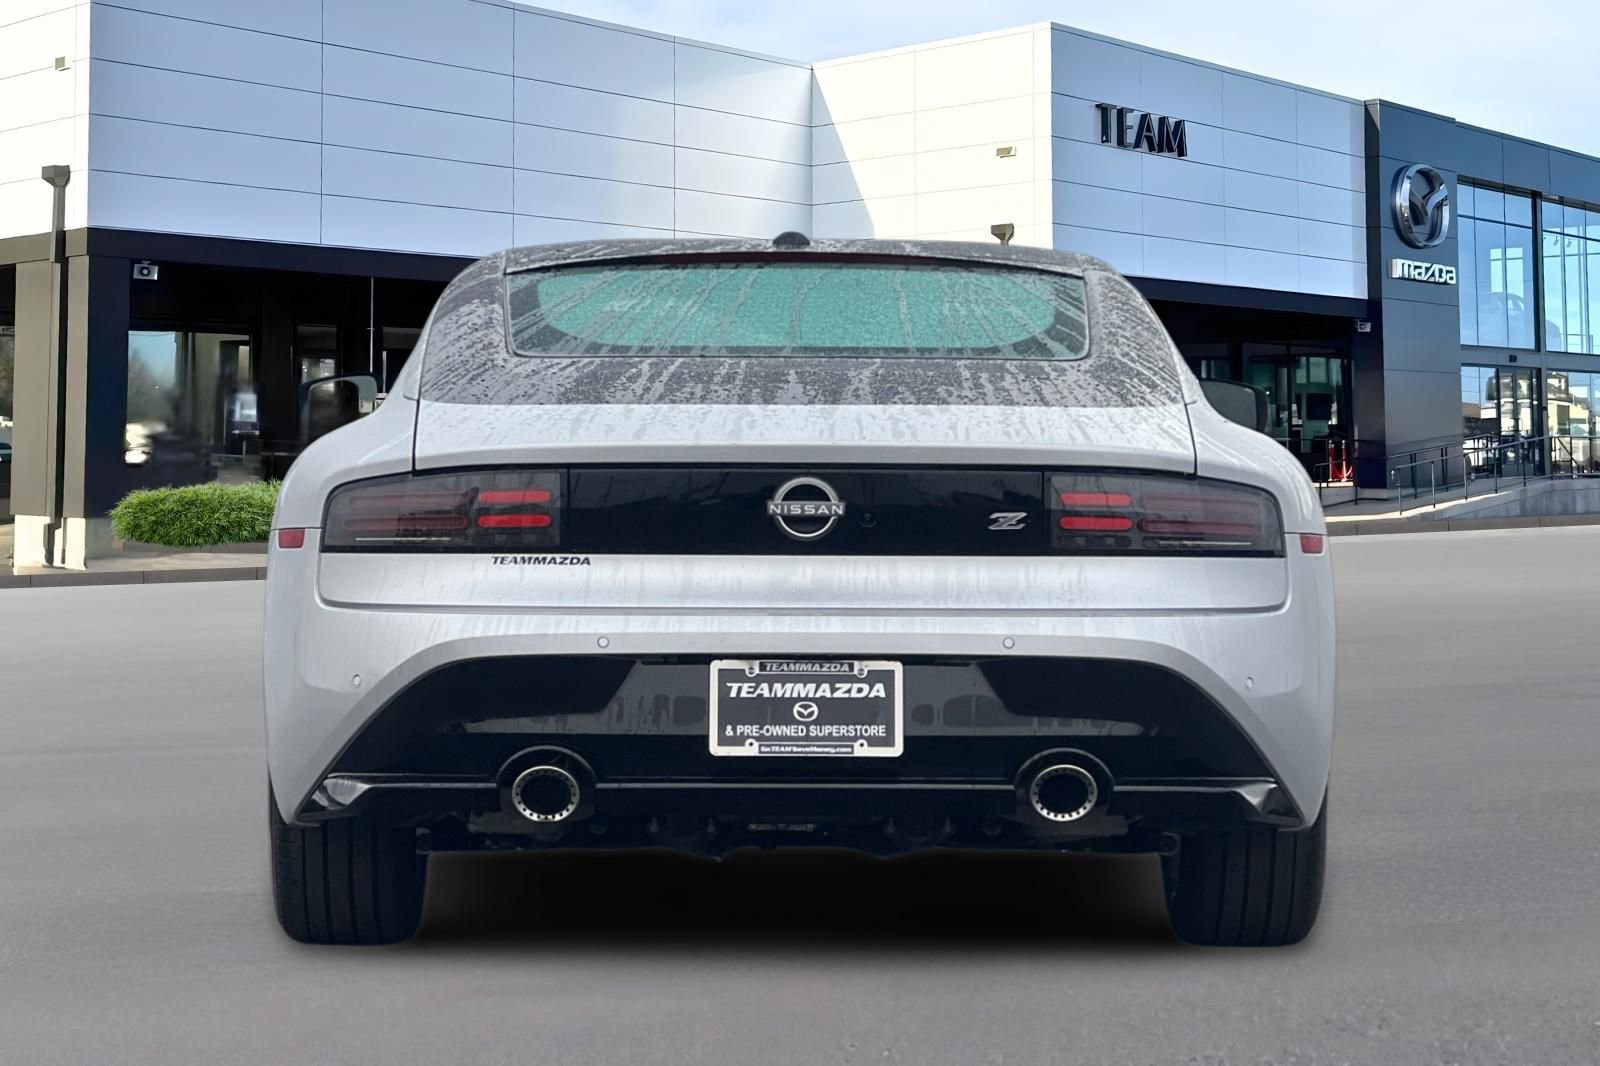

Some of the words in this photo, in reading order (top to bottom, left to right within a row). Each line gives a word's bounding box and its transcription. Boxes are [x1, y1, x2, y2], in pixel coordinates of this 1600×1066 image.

[1095, 102, 1187, 157] TEAM
[769, 504, 844, 515] NISSAN
[987, 512, 1027, 530] Z
[491, 555, 591, 566] TEAMMAZDA
[764, 662, 850, 672] TEAMMAZDA
[726, 682, 886, 698] TEAMMAZDA
[725, 725, 734, 737] &
[736, 725, 807, 737] PRE-OWNED
[809, 725, 887, 737] SUPERSTORE
